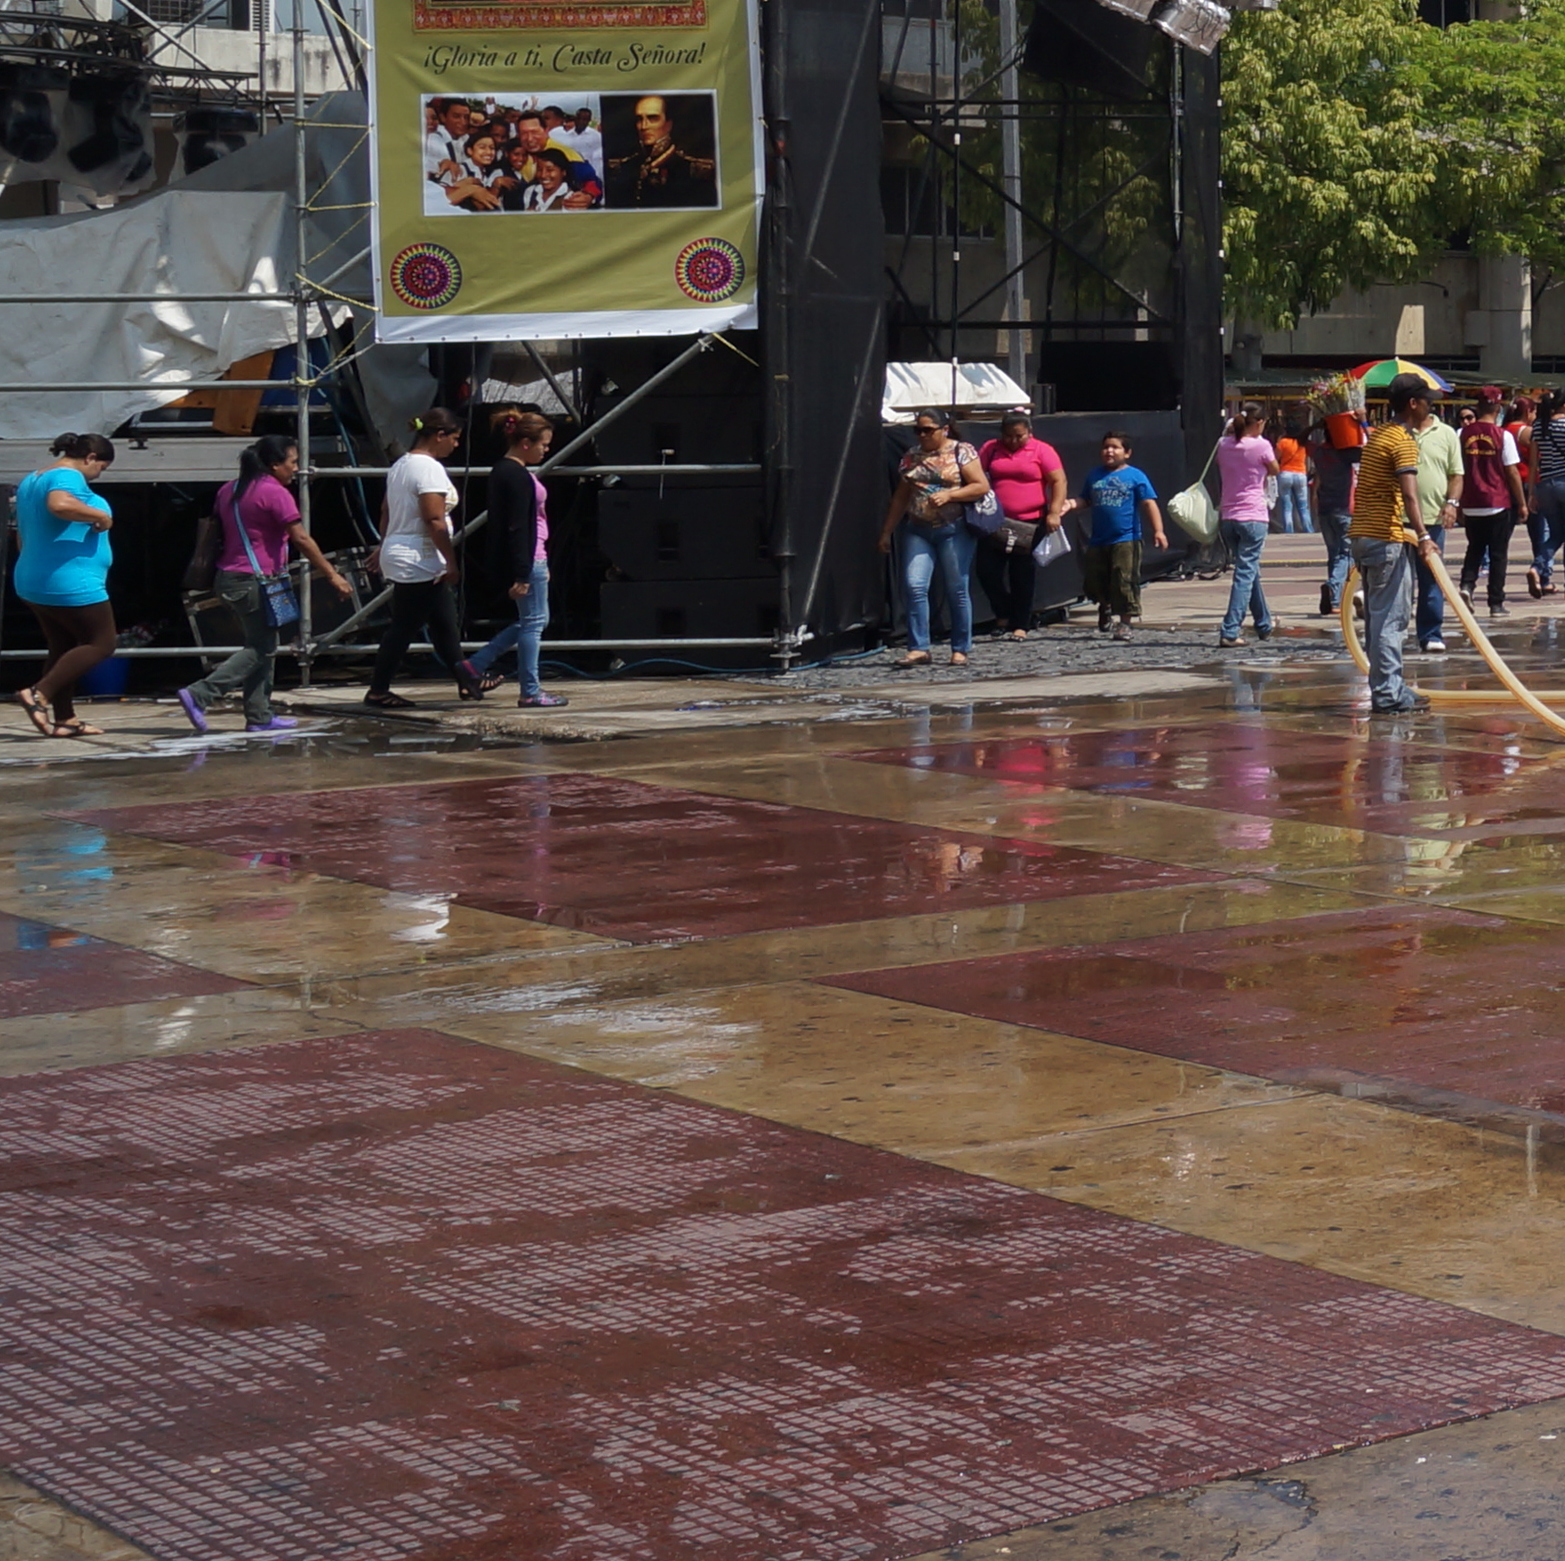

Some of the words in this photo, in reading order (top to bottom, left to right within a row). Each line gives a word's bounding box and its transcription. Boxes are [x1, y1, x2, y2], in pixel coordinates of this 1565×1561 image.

[424, 44, 498, 74] ¡Gloria
[504, 51, 517, 67] a
[523, 43, 544, 69] ti,
[552, 43, 613, 73] Casta
[616, 41, 706, 73] Señora!
